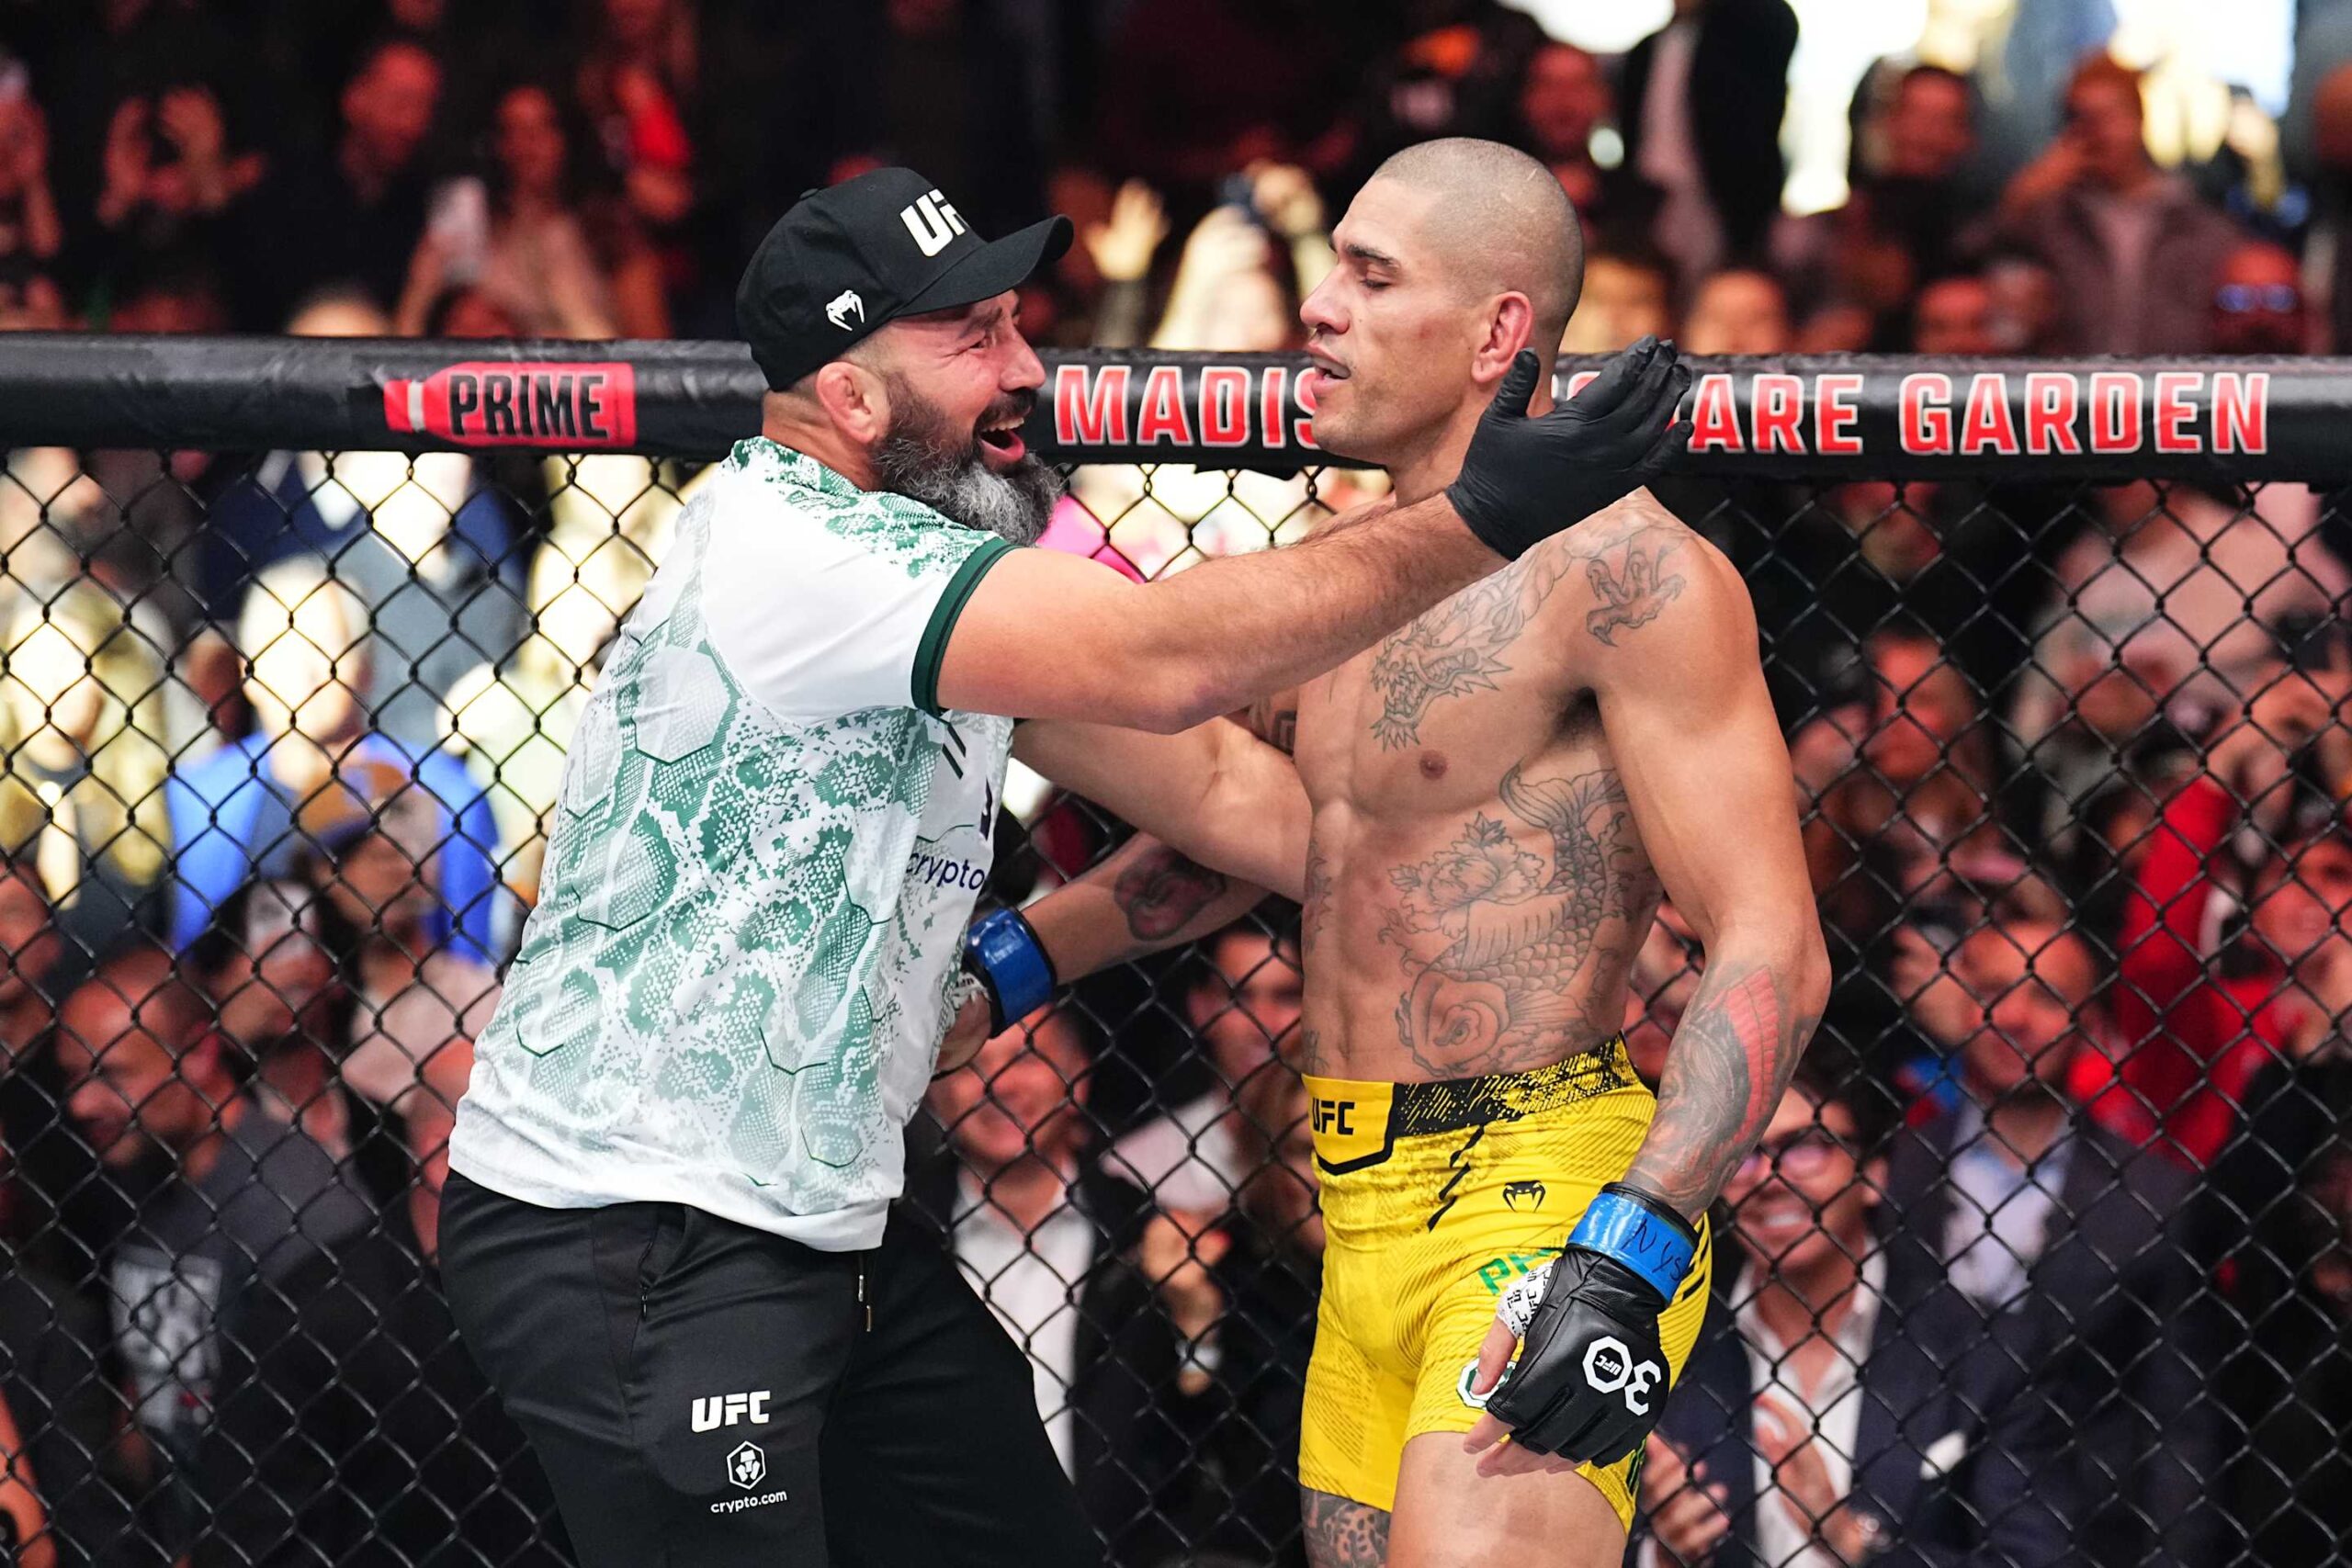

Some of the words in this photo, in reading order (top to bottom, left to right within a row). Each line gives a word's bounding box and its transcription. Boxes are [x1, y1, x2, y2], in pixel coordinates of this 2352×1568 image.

[899, 188, 969, 257] UF
[447, 373, 610, 441] PRIME
[1054, 365, 1321, 451] MADIS
[1899, 372, 2270, 455] GARDEN
[1312, 1097, 1355, 1135] UFC
[1594, 1354, 1623, 1376] UFC
[691, 1390, 771, 1433] UFC
[710, 1490, 787, 1514] crypto.com
